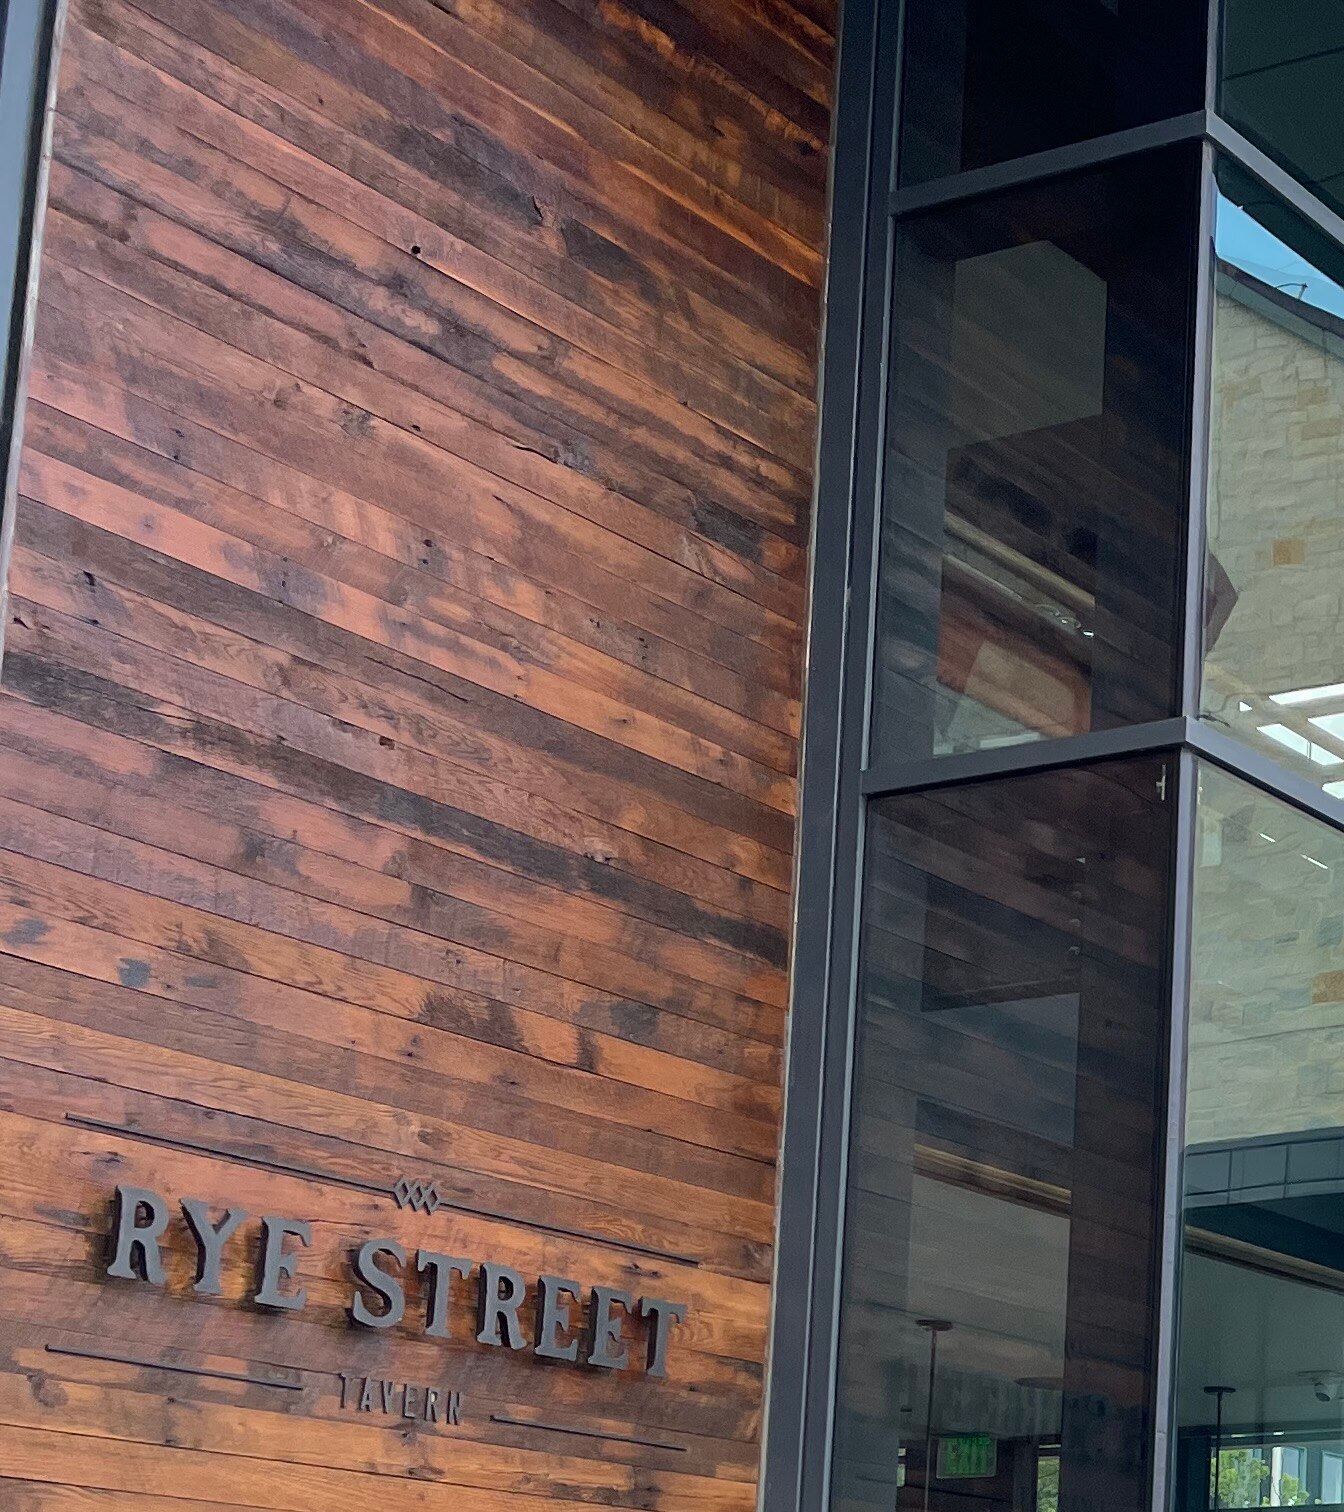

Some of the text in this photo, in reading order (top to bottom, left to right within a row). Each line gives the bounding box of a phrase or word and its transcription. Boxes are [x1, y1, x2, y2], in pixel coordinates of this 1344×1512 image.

[106, 1184, 688, 1378] RYE STREET
[336, 1371, 466, 1426] TAVERN
